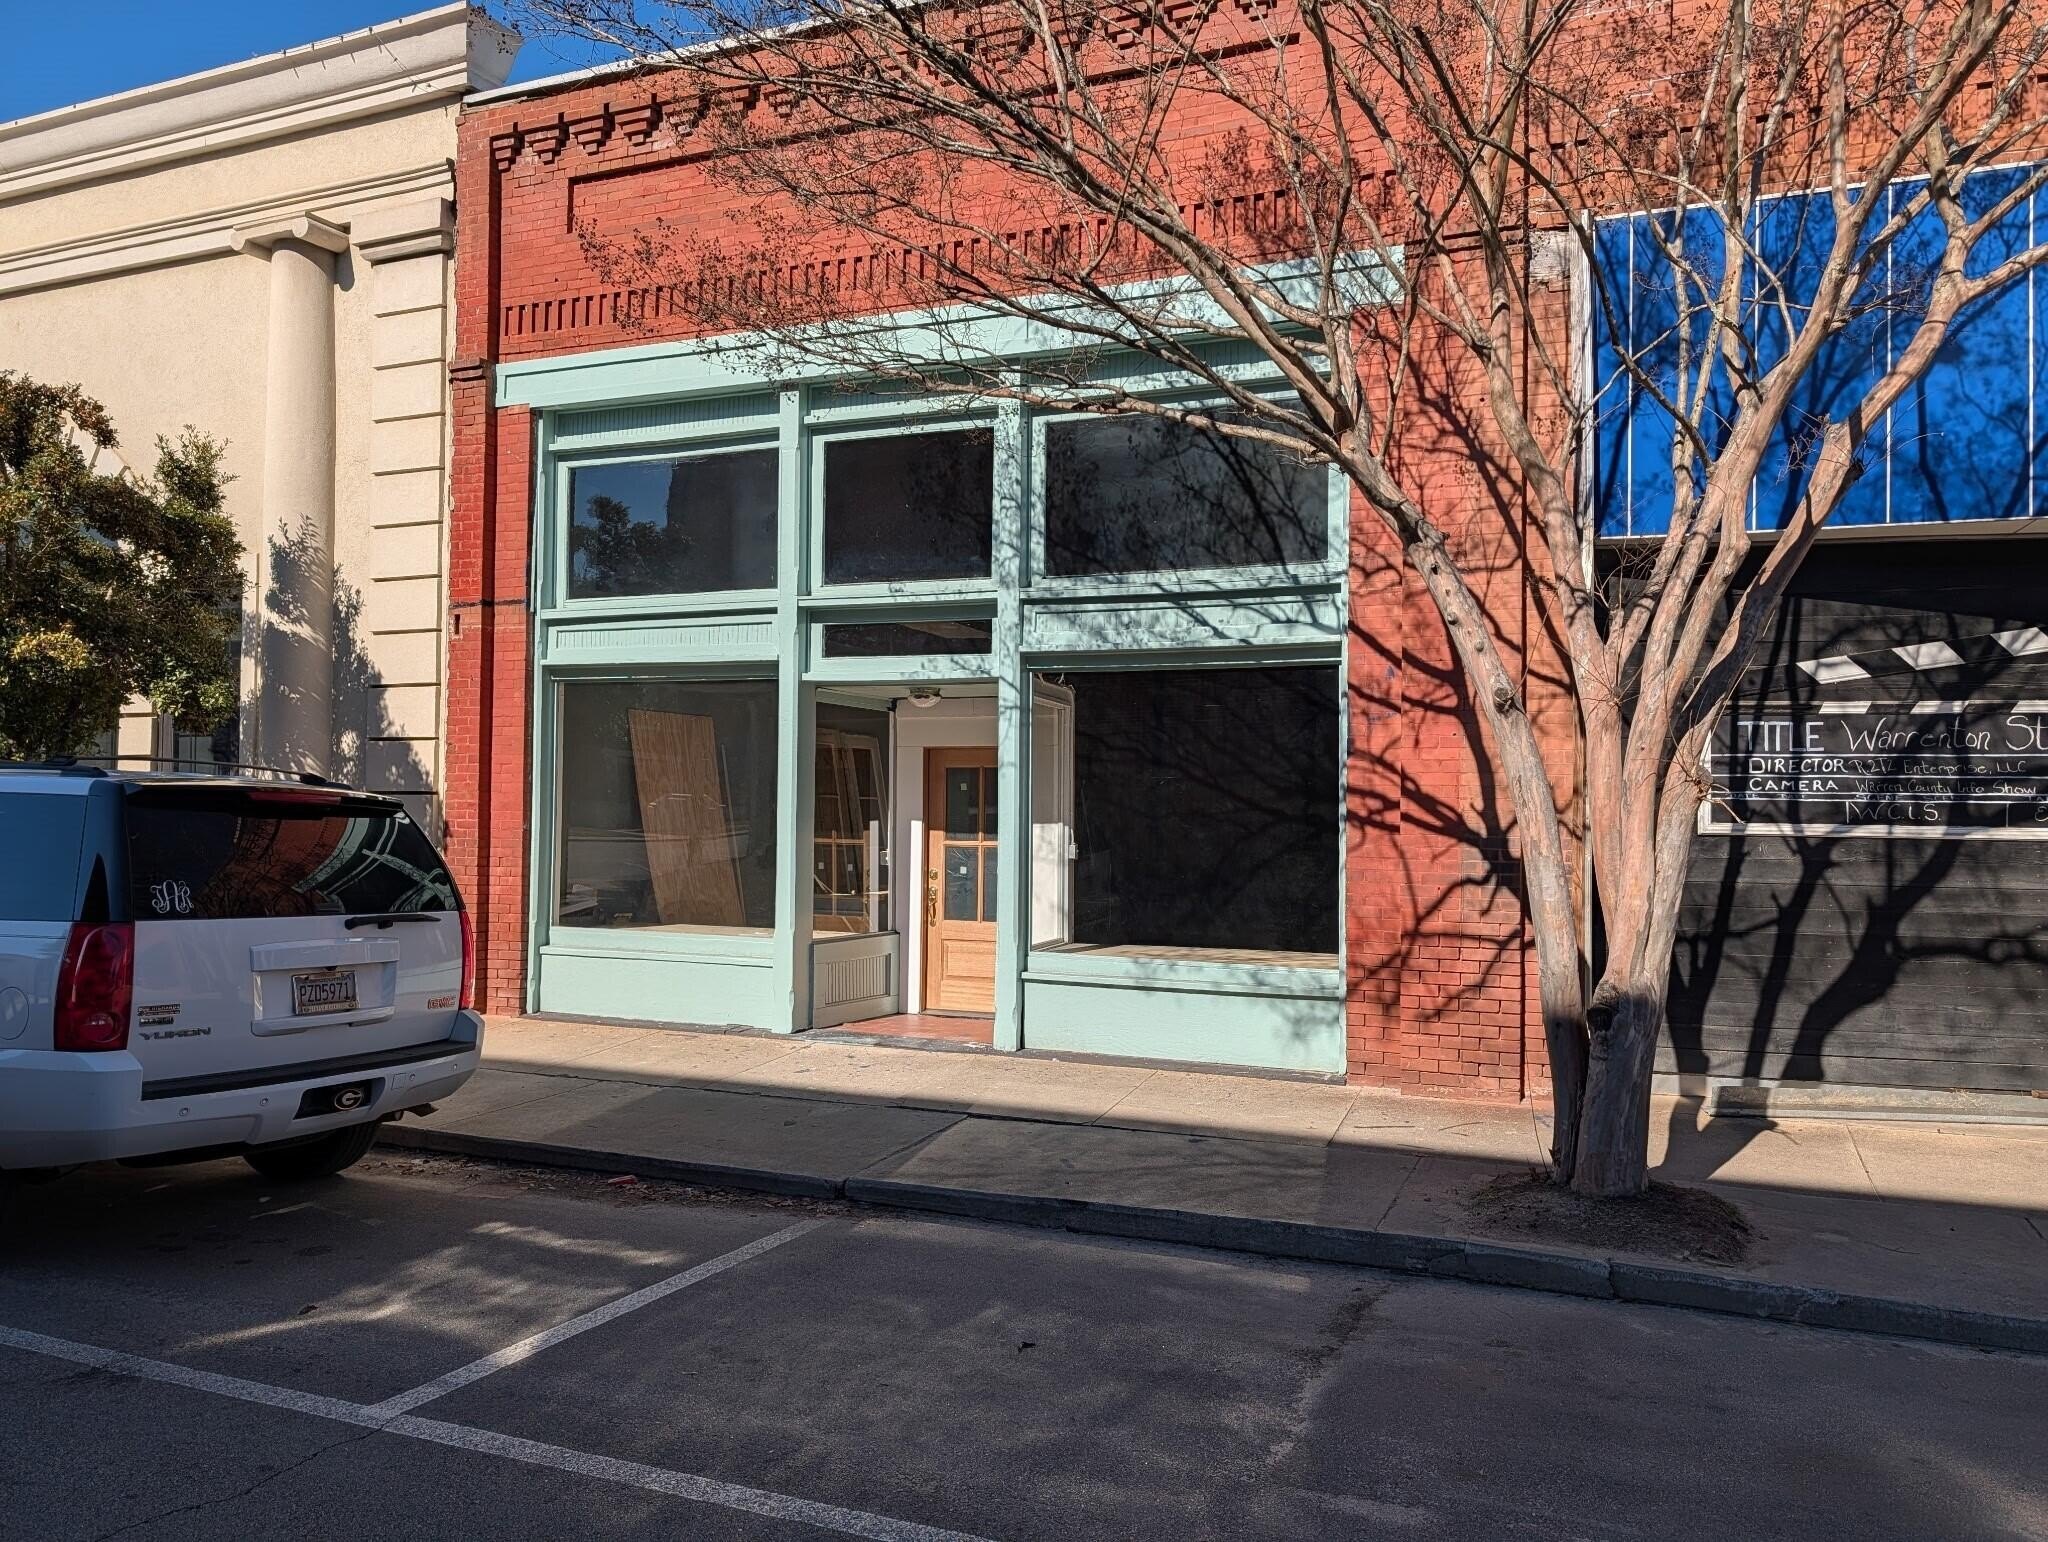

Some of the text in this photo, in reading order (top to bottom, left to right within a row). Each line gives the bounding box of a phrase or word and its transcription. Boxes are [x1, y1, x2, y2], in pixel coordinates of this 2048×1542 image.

[1736, 720, 1825, 752] TITLE
[1841, 716, 1991, 752] Warrenton
[1748, 757, 1849, 774] DIRECTOR
[1996, 760, 2027, 774] LLC
[1748, 777, 1839, 792] CAMERA
[1855, 778, 1904, 794] Warren
[1907, 779, 1952, 796] County
[1992, 780, 2037, 795] Show
[427, 996, 457, 1010] GMC
[138, 1026, 212, 1041] YUKON
[339, 1089, 363, 1108] G
